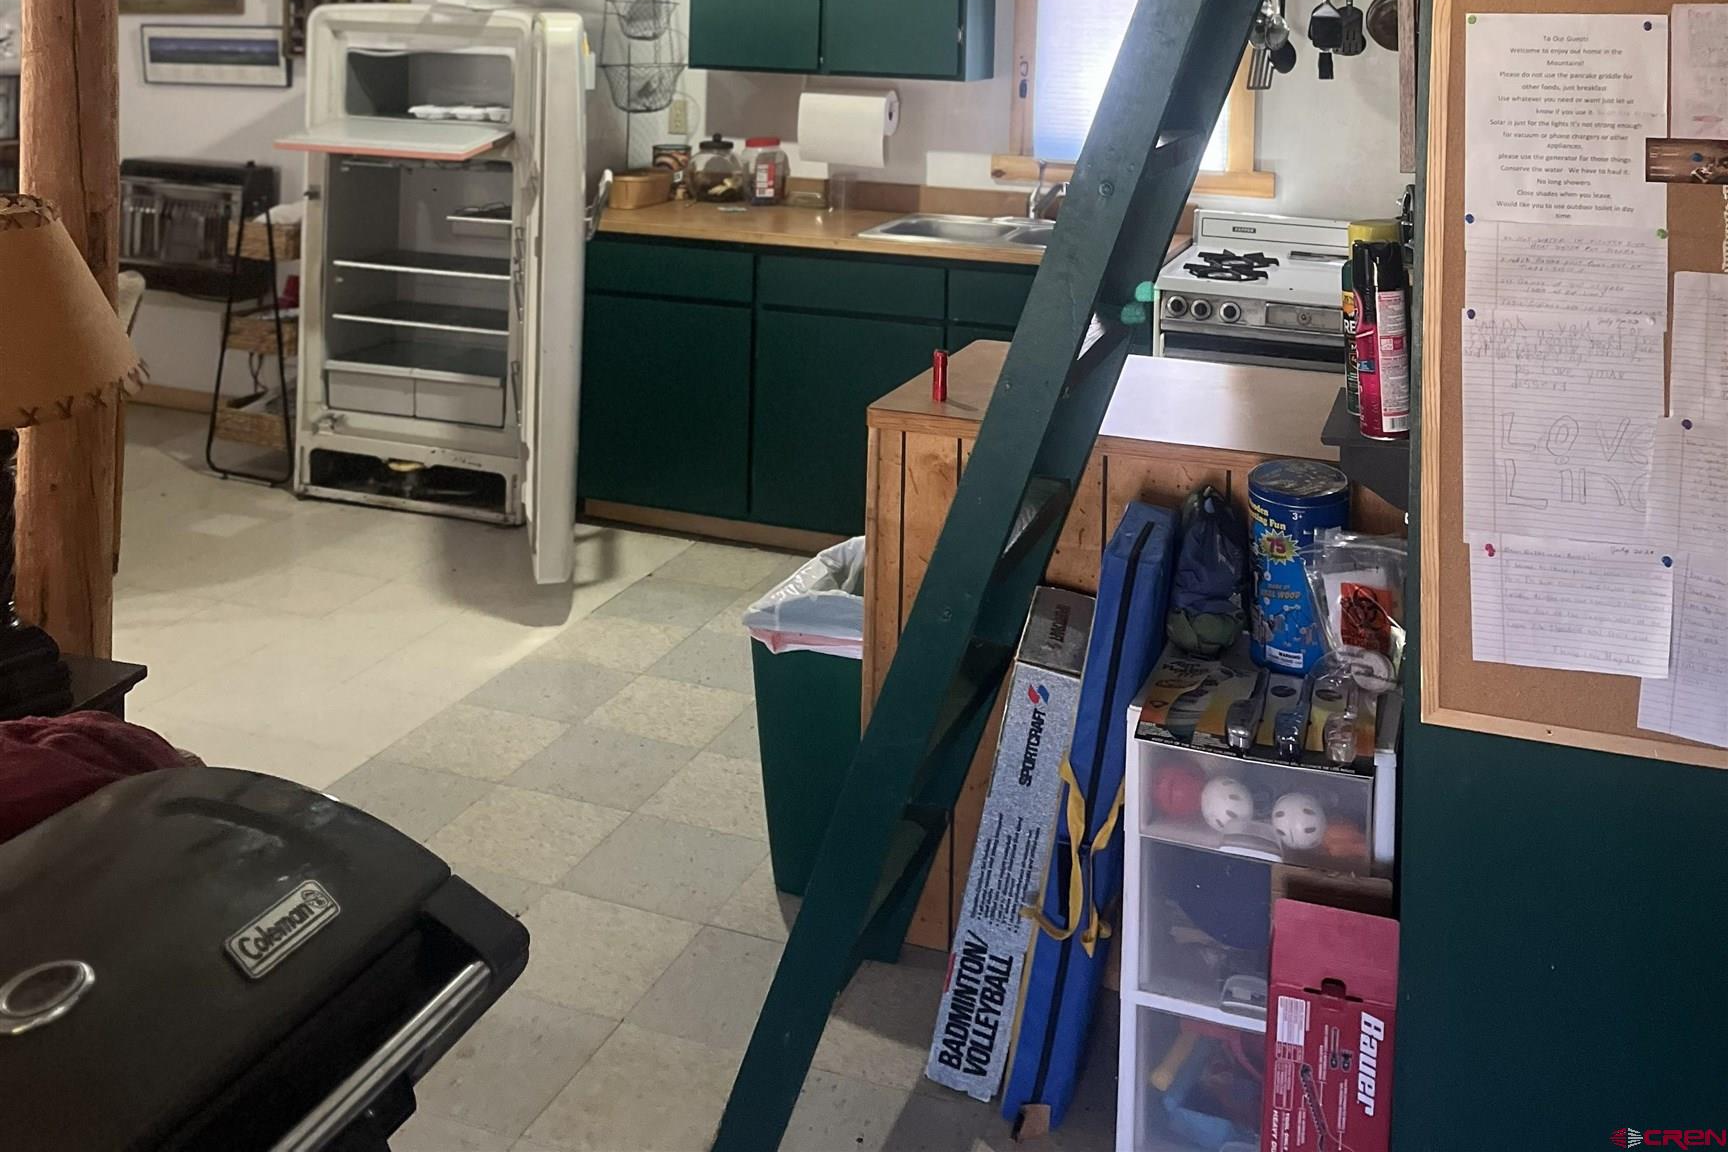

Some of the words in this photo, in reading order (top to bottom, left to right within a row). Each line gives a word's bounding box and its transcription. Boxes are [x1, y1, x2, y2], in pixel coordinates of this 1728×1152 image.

[1550, 48, 1568, 56] enjoy
[1550, 120, 1569, 128] lights
[1594, 122, 1615, 130] strong
[1617, 122, 1642, 130] enough
[1549, 132, 1569, 140] phone
[1571, 134, 1600, 142] chargers
[1269, 518, 1287, 531] Fun
[1291, 512, 1303, 521] 3+
[1266, 537, 1287, 555] 75
[1018, 707, 1047, 788] SPORTCRAFT
[238, 902, 315, 960] Coleman
[938, 929, 989, 1071] BADMINTON/
[962, 954, 1014, 1078] VOLLEYBALL
[1357, 1011, 1385, 1117] Bauer
